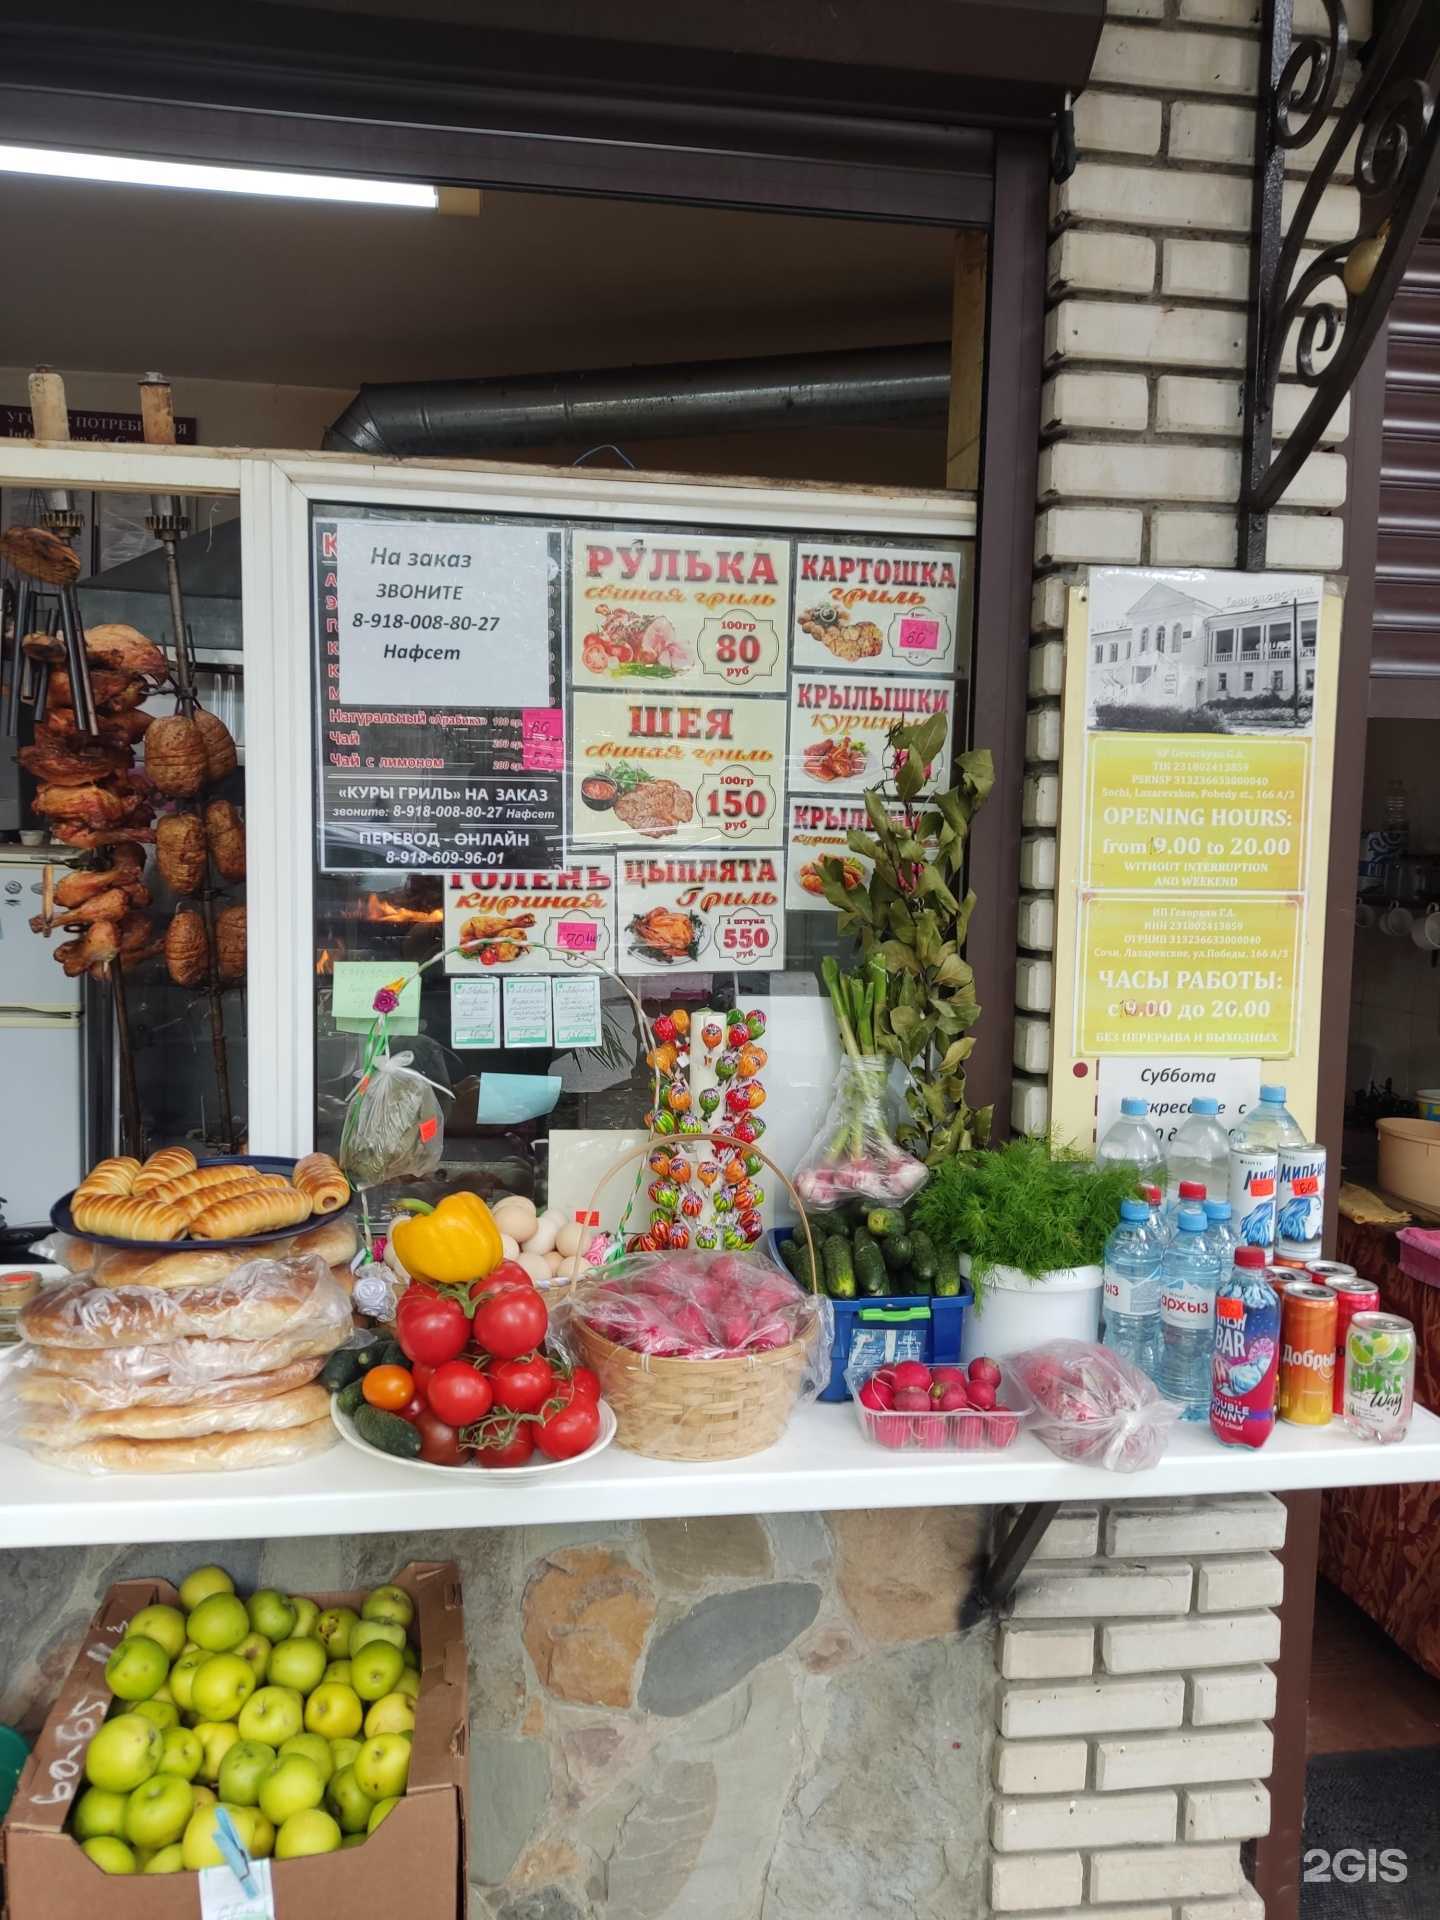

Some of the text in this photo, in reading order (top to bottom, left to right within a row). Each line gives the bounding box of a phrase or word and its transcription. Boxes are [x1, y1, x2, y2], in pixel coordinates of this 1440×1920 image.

[370, 548, 472, 568] На заказ
[585, 544, 779, 585] РУЛЬКА
[800, 554, 957, 589] КАРТОШКА
[376, 583, 464, 601] ЗВОНИТЕ
[352, 612, 500, 631] 8-918-008-80-27
[721, 621, 756, 632] 100гр
[383, 644, 461, 663] Нафсет
[715, 634, 761, 664] 80
[726, 666, 749, 677] руб
[797, 683, 950, 713] КРЫЛЫШКИ
[329, 709, 427, 726] Натуральный
[628, 706, 733, 740] ШЕЯ
[329, 730, 360, 745] Чай
[329, 753, 360, 767] Чай
[366, 757, 374, 767] с
[379, 757, 444, 769] лимоном
[720, 776, 753, 787] 100гр
[339, 786, 548, 802] «КУРЫ ГРИЛЬ» НА ЗАКАЗ
[393, 805, 502, 819] 8-918-008-80-27
[506, 810, 555, 820] Нафсет
[706, 790, 767, 818] 150
[724, 820, 748, 831] руб
[1103, 807, 1293, 827] OPENING HOURS:
[359, 832, 440, 847] ПЕРЕВОД
[454, 833, 529, 847] ОНЛАЙН
[1103, 837, 1291, 855] from 9.00 to 20.00
[386, 851, 504, 865] 8-918-609-96-01
[624, 859, 777, 888] ЦЫПЛЯТА
[1124, 862, 1268, 873] WITHOUT INTERRUPTION
[1154, 877, 1238, 887] AND WEEKEND
[723, 928, 770, 949] 550
[1099, 970, 1283, 990] ЧАСЫ РАБОТЫ:
[1108, 1004, 1117, 1017] с
[1177, 1003, 1205, 1020] до
[1211, 999, 1270, 1017] 20.00
[1140, 1068, 1216, 1086] Суббота
[1238, 1103, 1247, 1115] с
[1215, 1327, 1246, 1357] BAR
